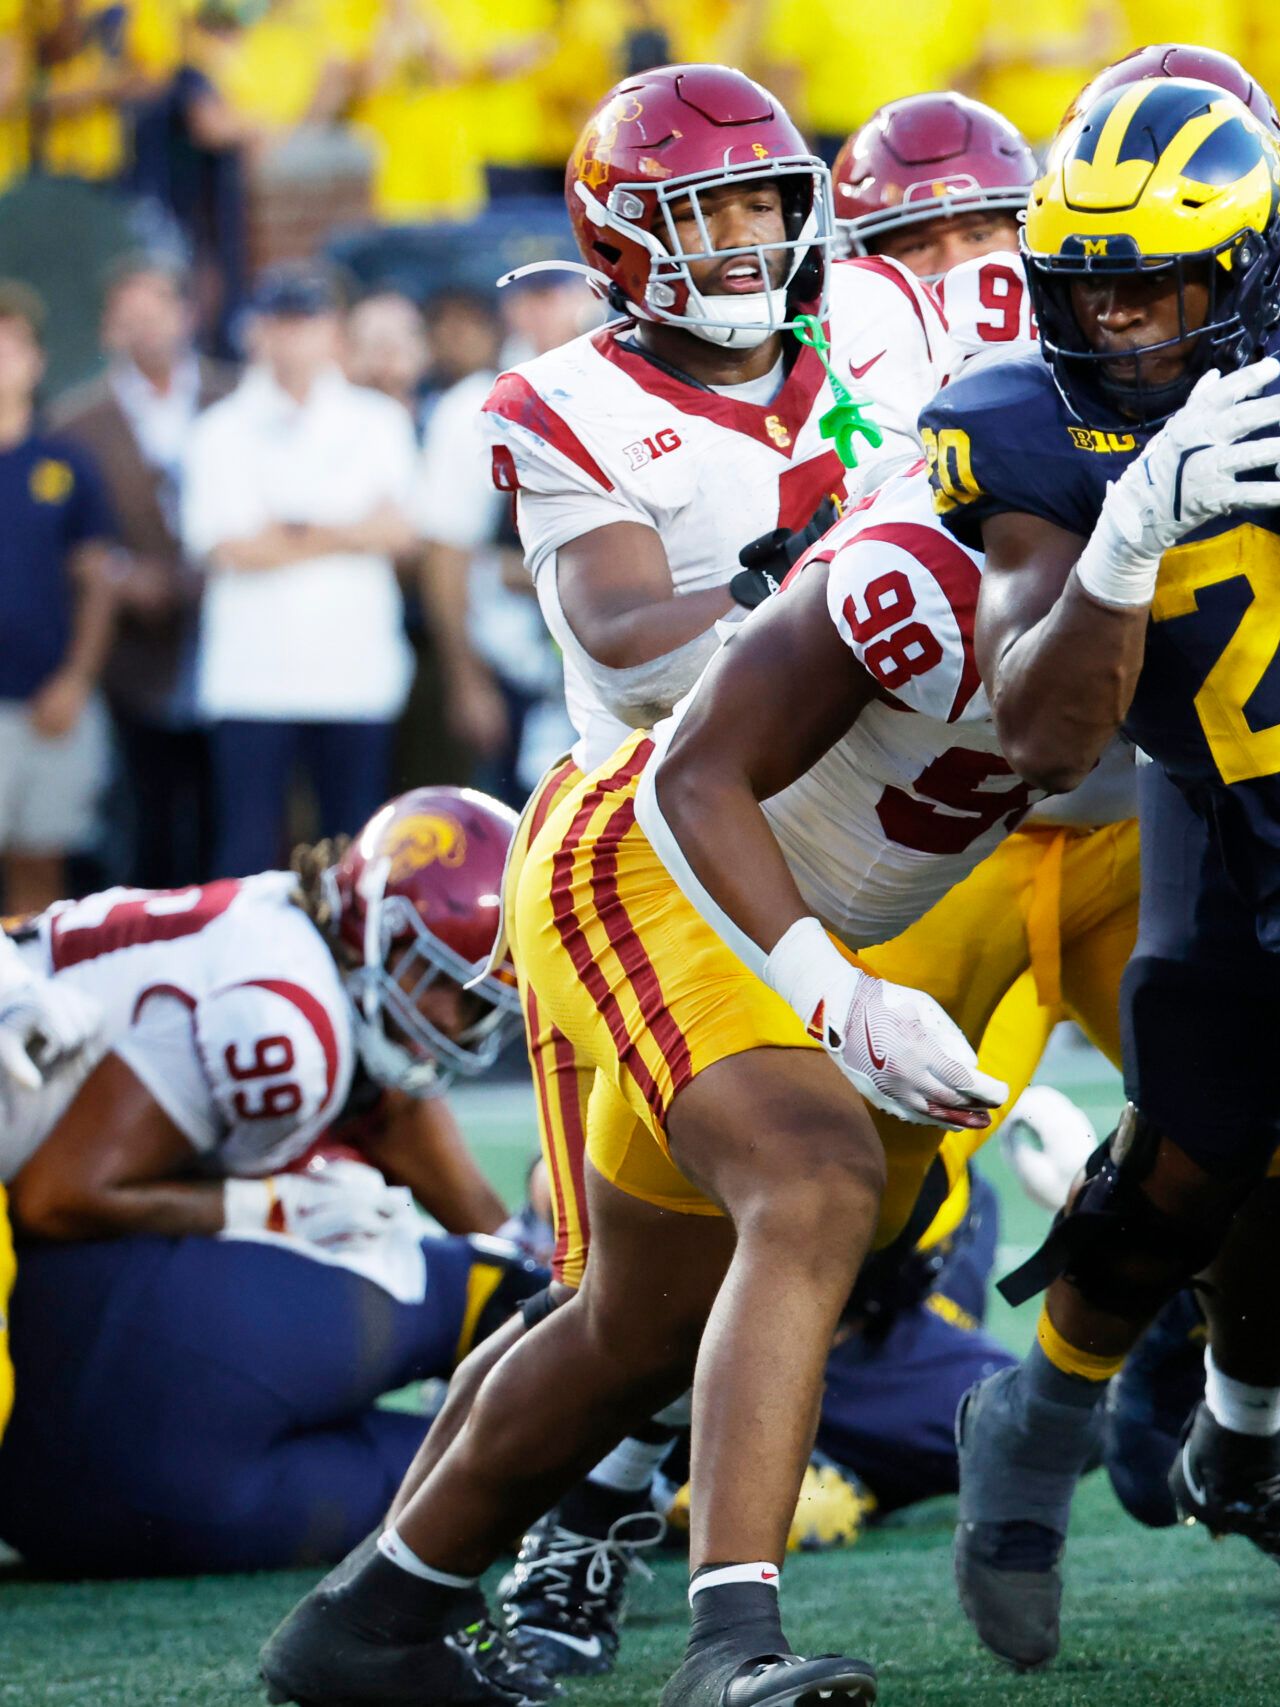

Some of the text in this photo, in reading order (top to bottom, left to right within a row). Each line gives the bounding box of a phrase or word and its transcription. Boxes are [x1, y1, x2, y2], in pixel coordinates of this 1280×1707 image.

[1083, 239, 1108, 256] M
[976, 263, 1040, 342] 9
[842, 569, 944, 690] 98
[225, 1034, 303, 1120] 99
